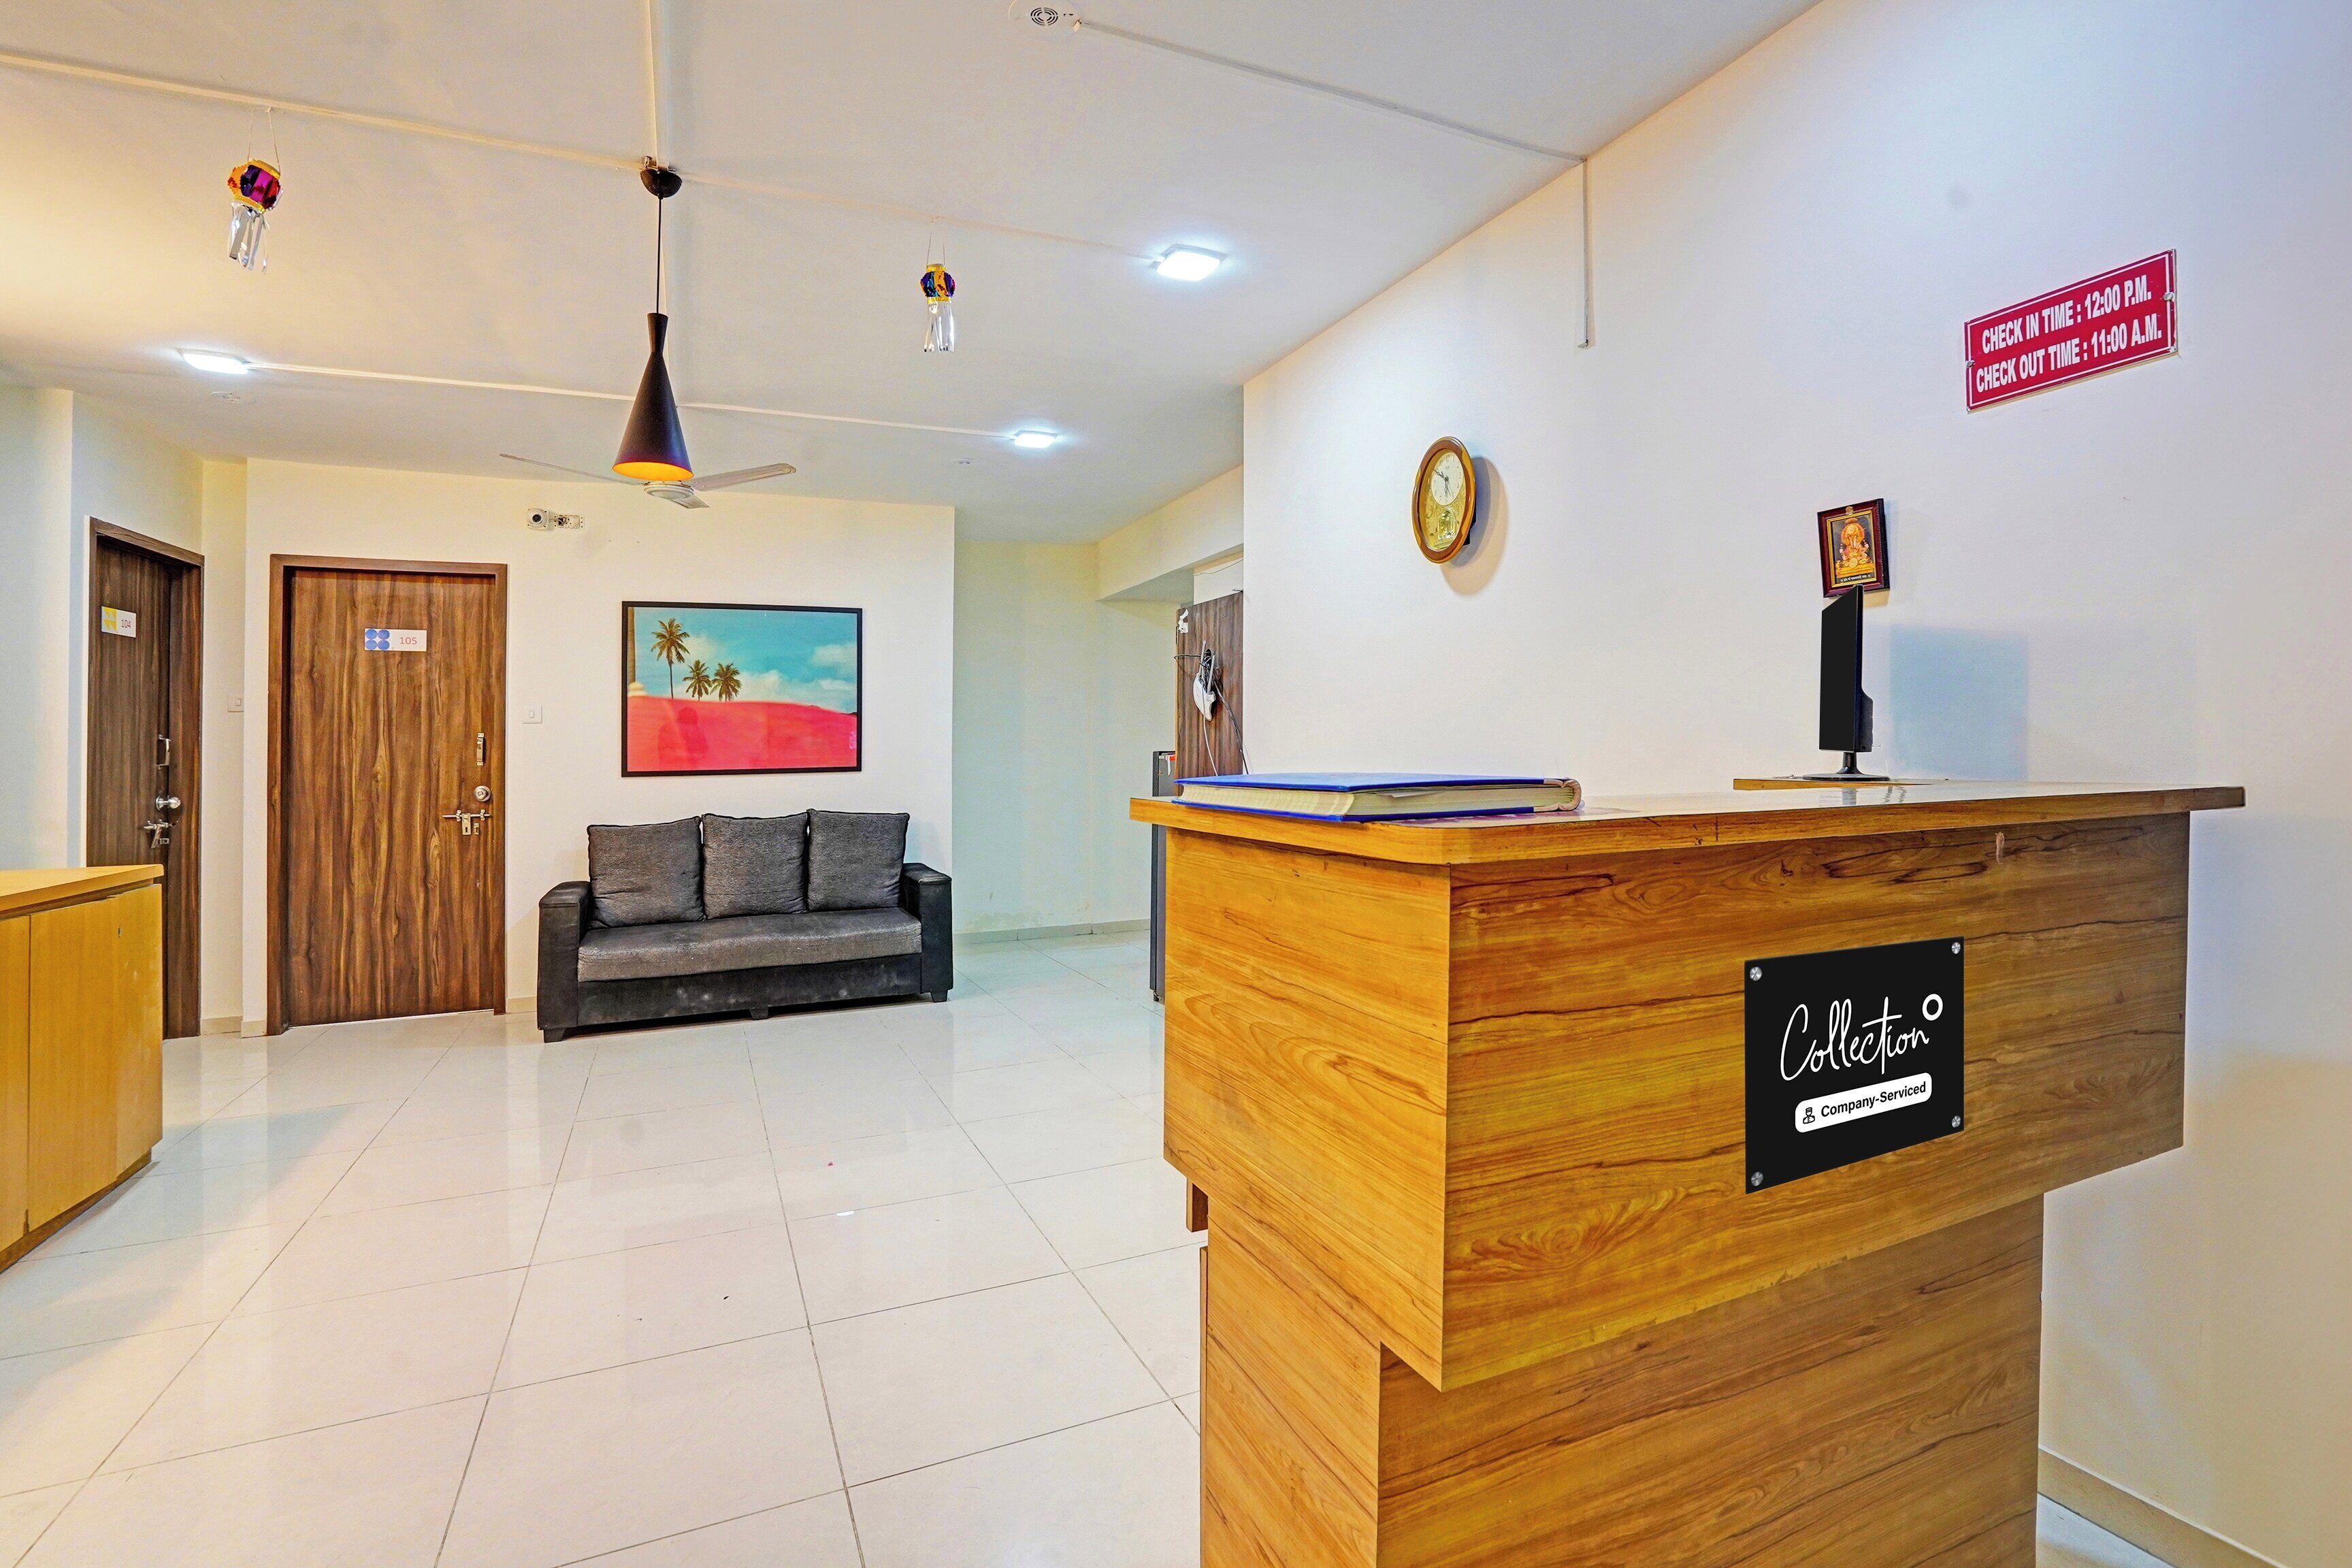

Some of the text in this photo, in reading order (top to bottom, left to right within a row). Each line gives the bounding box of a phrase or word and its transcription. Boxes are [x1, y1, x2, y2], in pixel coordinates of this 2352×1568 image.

[1982, 321, 2023, 354] CHECK
[2026, 312, 2040, 340] IN
[2042, 300, 2074, 333] TIME
[2085, 284, 2121, 320] 12:00
[2124, 274, 2152, 307] P.M.
[1976, 358, 2017, 393] CHECK
[2019, 349, 2046, 380] OUT
[2048, 338, 2080, 371] TIME
[2091, 323, 2127, 358] 11:00
[2131, 313, 2162, 346] A.M.
[121, 619, 131, 629] 104
[399, 636, 418, 645] 105
[1780, 996, 1930, 1081] Collection
[1821, 1082, 1926, 1114] Company-Serviced
